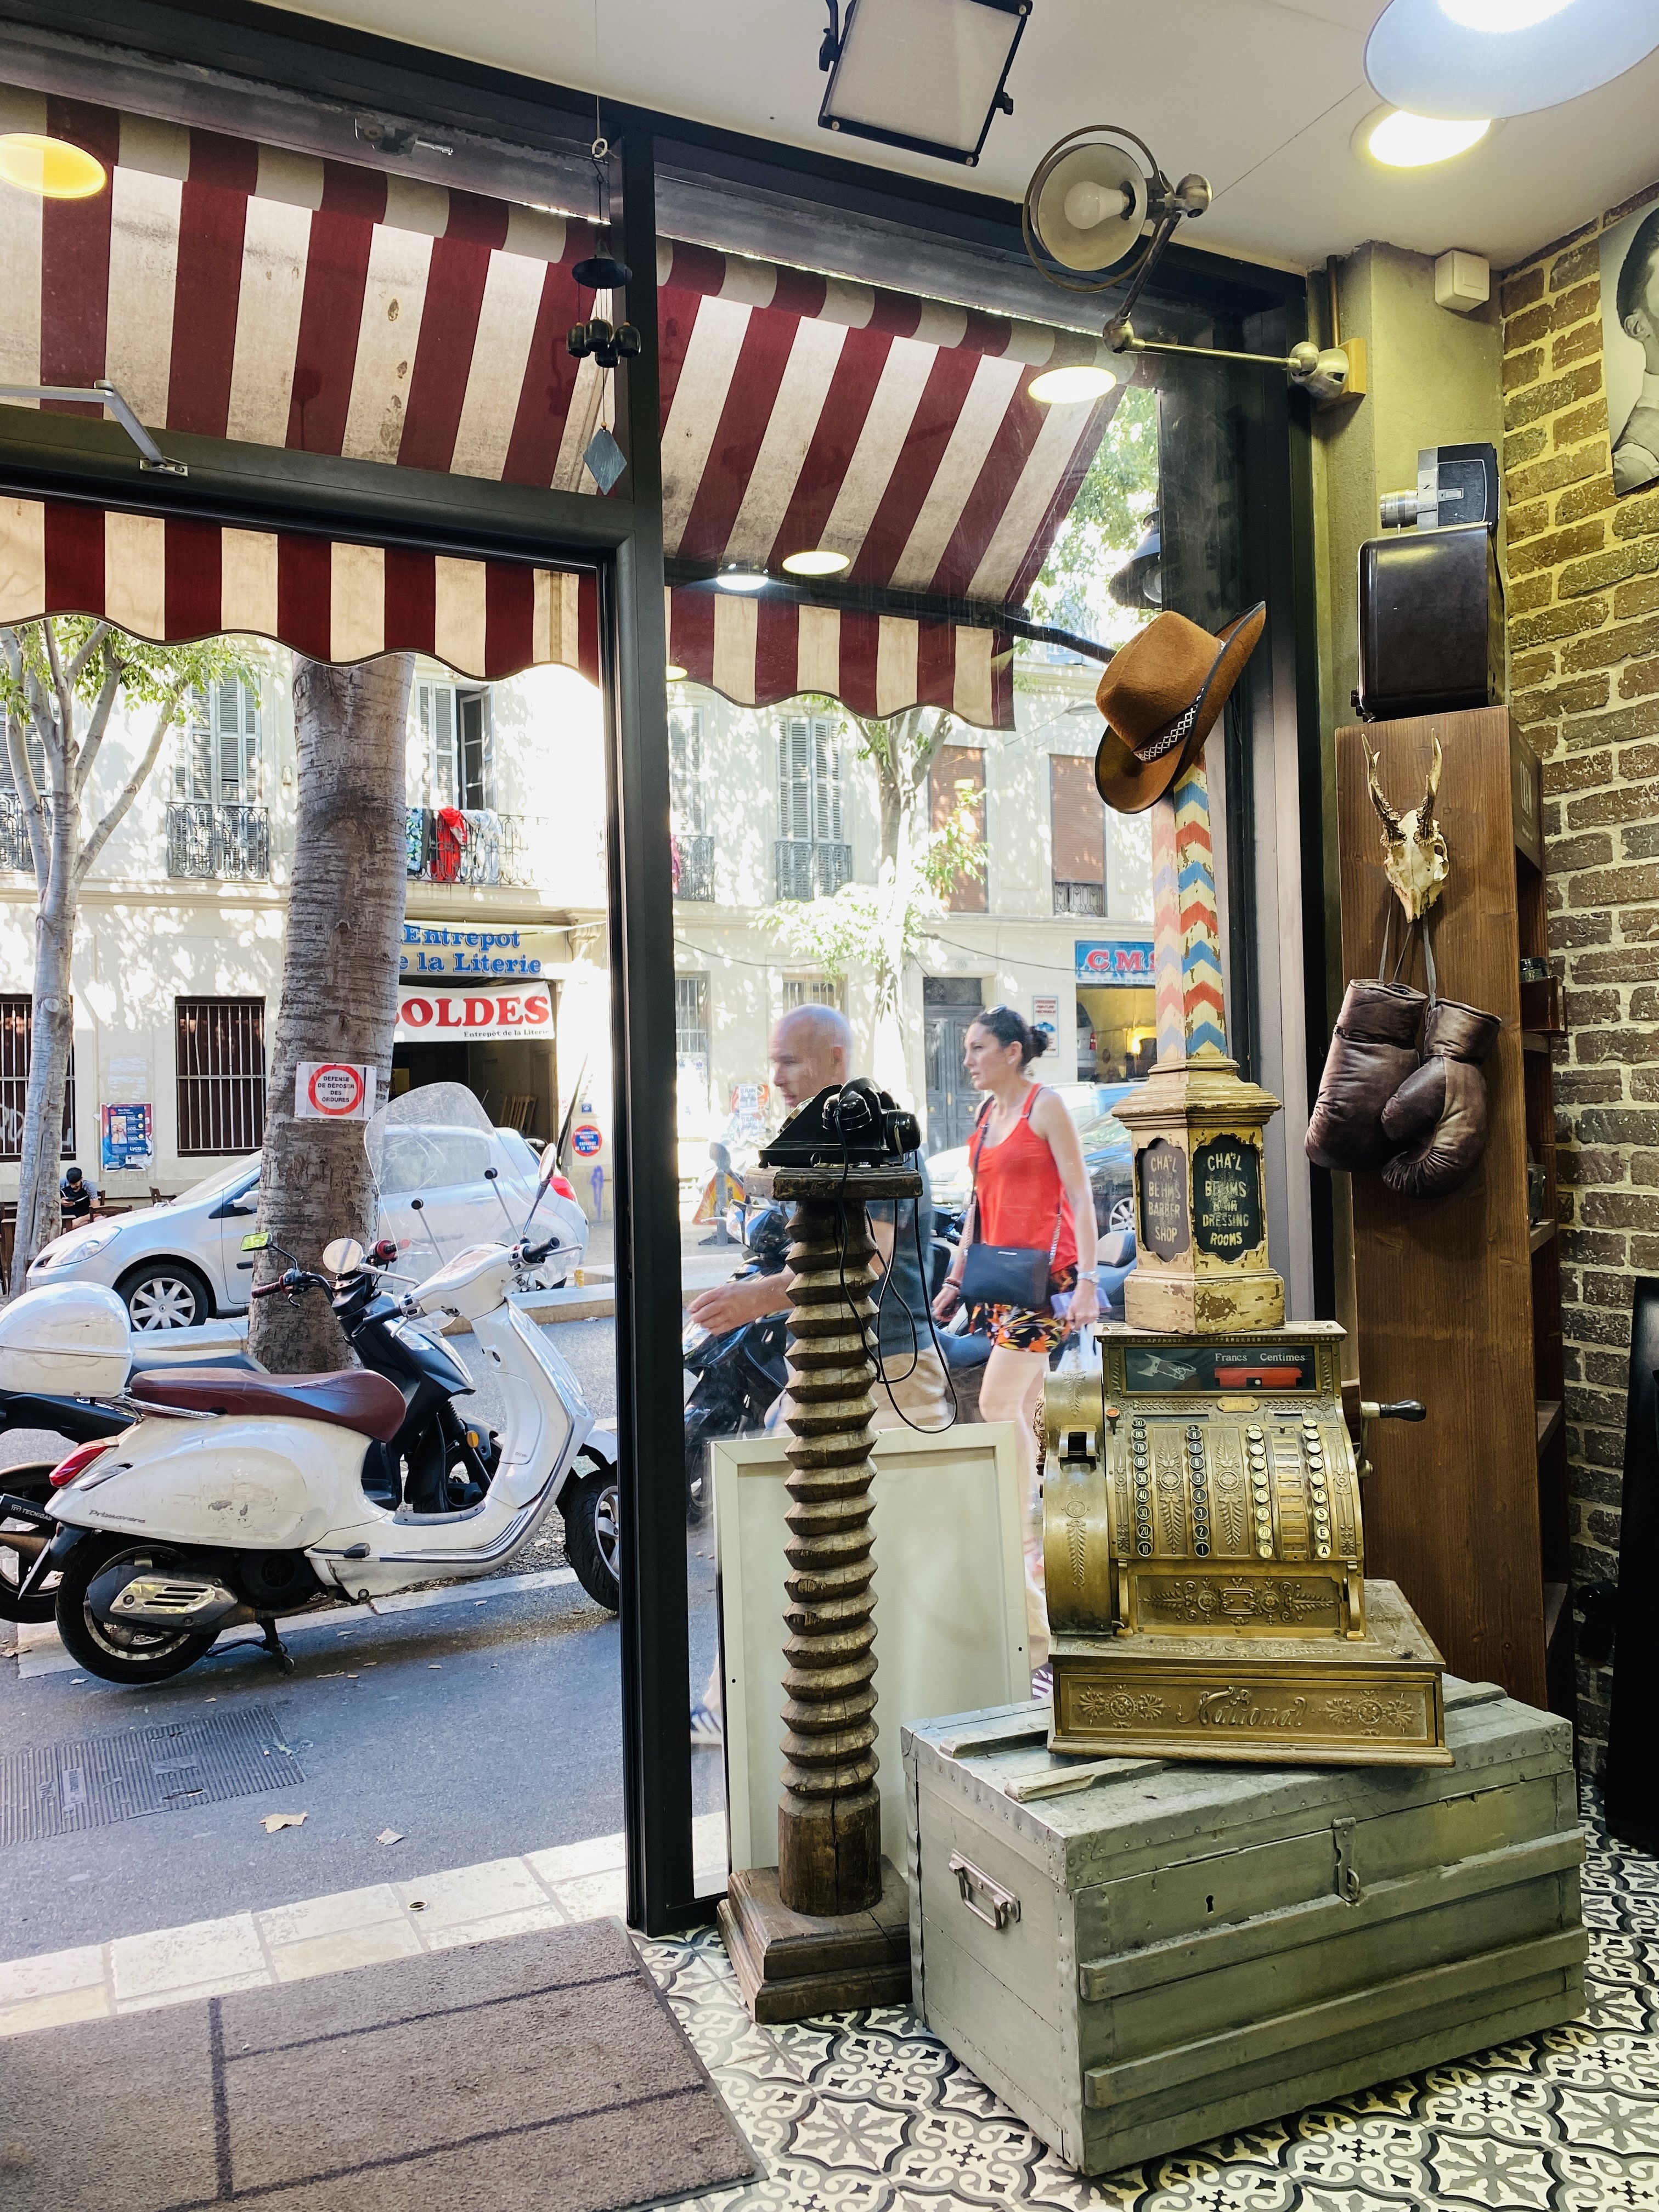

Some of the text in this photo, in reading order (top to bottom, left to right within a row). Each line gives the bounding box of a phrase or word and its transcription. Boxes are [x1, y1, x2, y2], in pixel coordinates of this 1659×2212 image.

[399, 952, 543, 974] e la Literie
[395, 996, 549, 1027] OLDES
[1148, 1201, 1180, 1218] BARBER
[1203, 1214, 1249, 1227] DRESSING
[1155, 1226, 1178, 1243] SHOP
[1210, 1232, 1243, 1246] ROOMS
[1215, 1353, 1306, 1362] Francs Centimes
[1194, 1458, 1199, 1466] 6
[1196, 1474, 1201, 1482] 5
[1256, 1475, 1264, 1483] 50
[1139, 1491, 1147, 1499] 40
[1197, 1491, 1201, 1500] 4
[1258, 1492, 1266, 1500] 40
[89, 1509, 146, 1523] Primavera
[1139, 1509, 1148, 1517] 30
[1198, 1509, 1203, 1518] 3
[1260, 1509, 1267, 1518] 30
[1319, 1509, 1324, 1518] S
[1141, 1527, 1148, 1536] 20
[1199, 1527, 1204, 1536] 2
[1261, 1528, 1268, 1537] 20
[1142, 1545, 1148, 1554] 10
[1201, 1545, 1204, 1555] 1
[1262, 1546, 1269, 1555] 10
[1176, 1686, 1307, 1728] National
